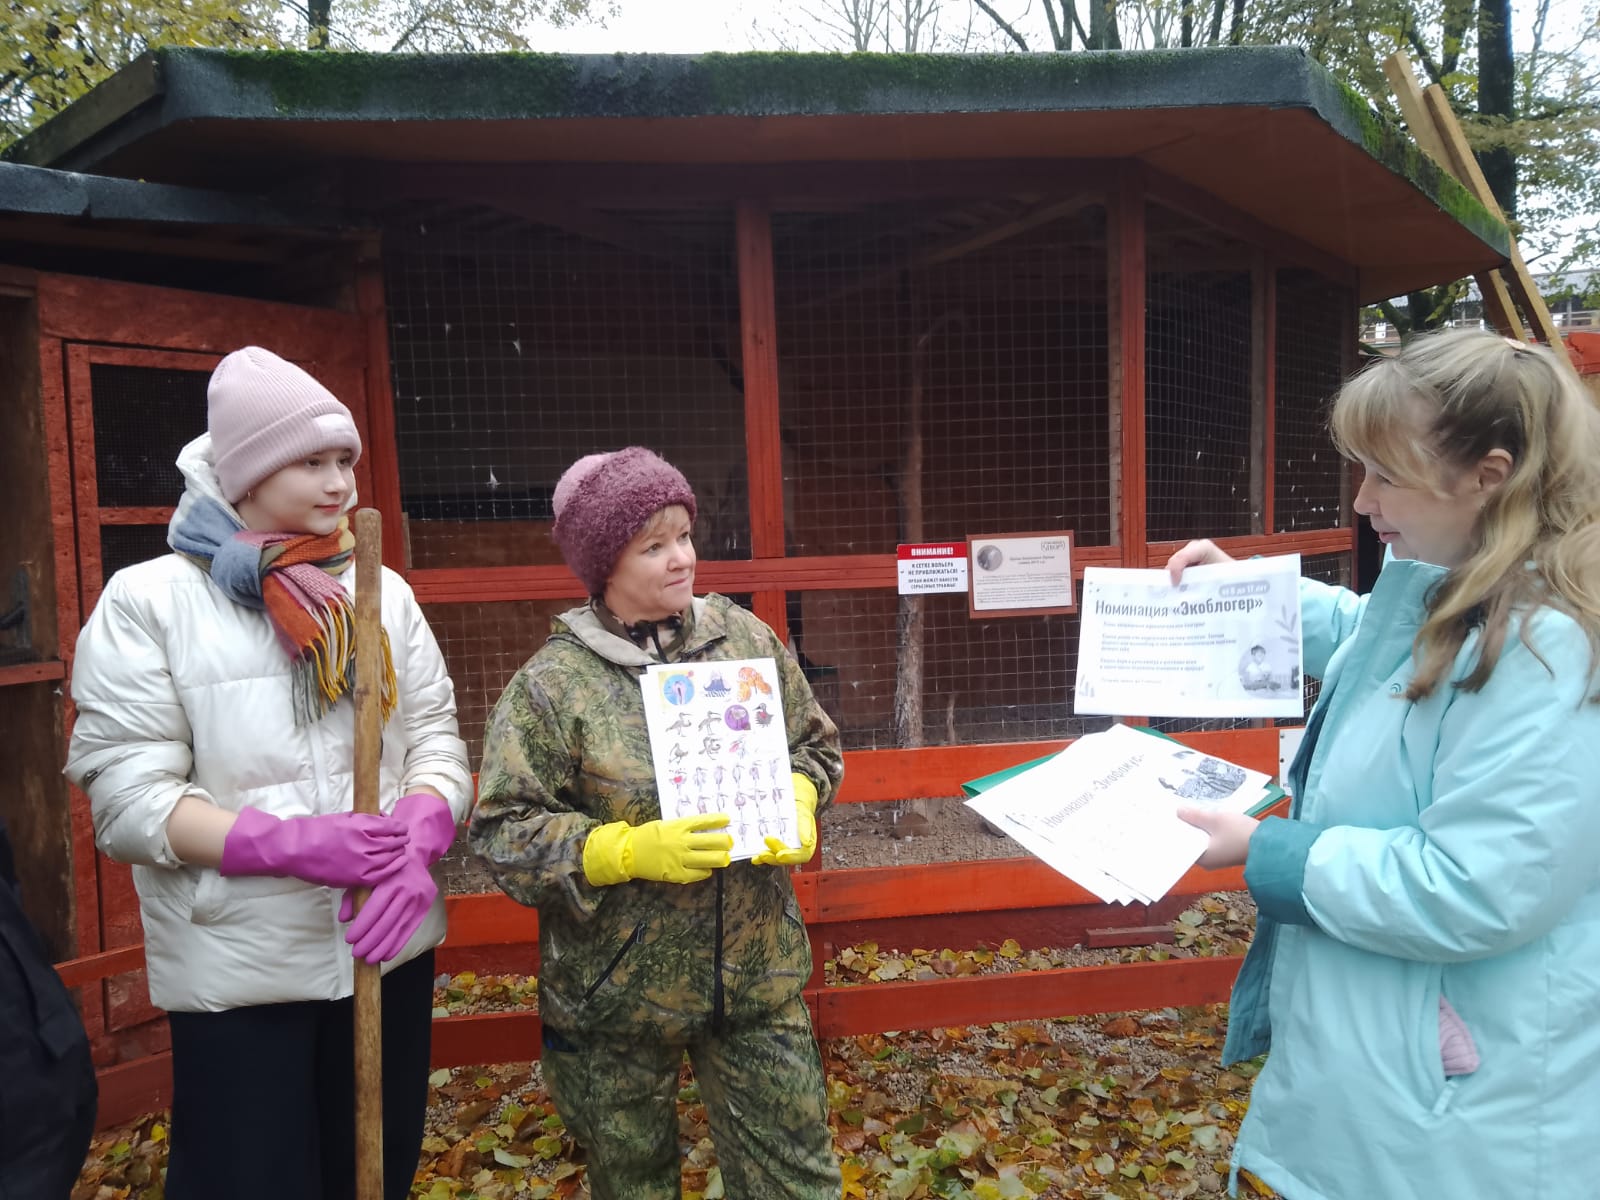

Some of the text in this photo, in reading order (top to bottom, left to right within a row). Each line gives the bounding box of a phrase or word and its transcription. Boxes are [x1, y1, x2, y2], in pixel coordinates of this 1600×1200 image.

[911, 546, 953, 556] ВНИМАНИЕ!
[1095, 598, 1263, 618] Номинация «Экоблогер»
[1040, 791, 1094, 828] Номинация
